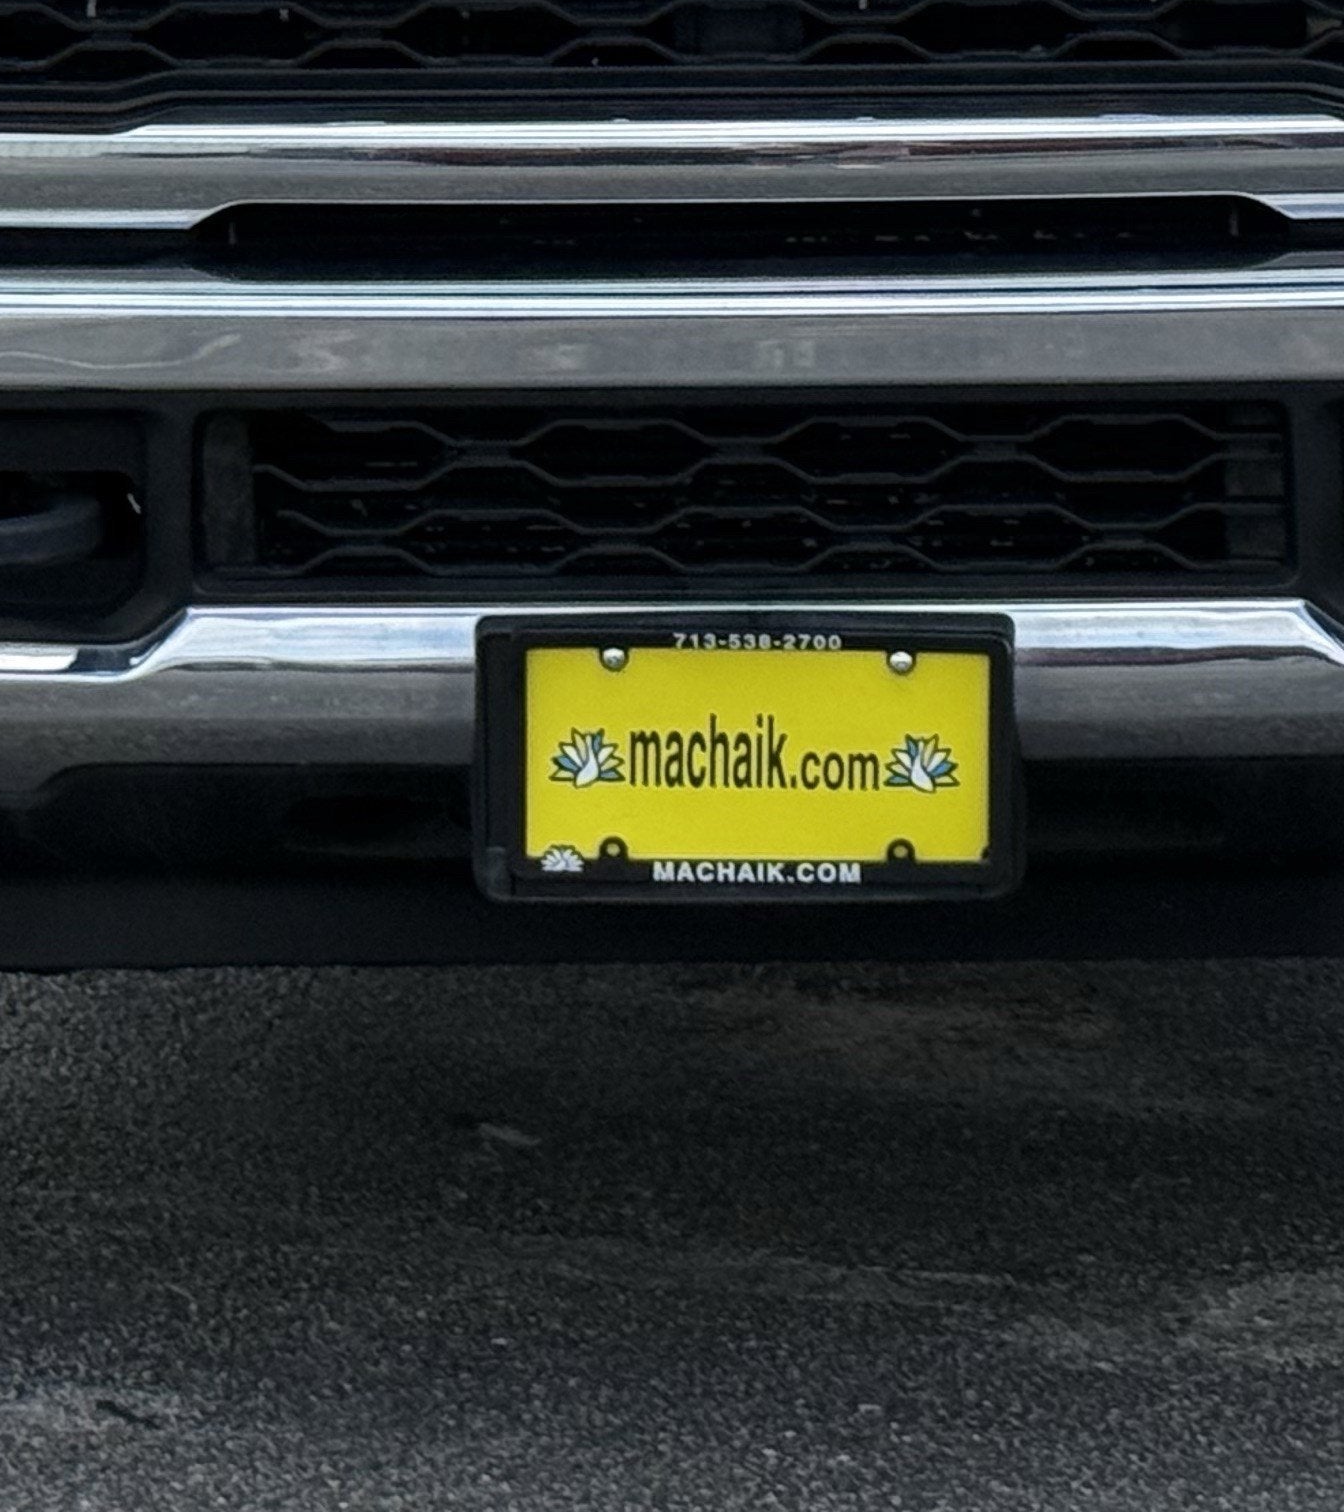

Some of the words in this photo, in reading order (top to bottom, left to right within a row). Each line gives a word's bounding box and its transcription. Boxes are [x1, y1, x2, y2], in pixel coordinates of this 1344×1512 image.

[672, 632, 843, 651] 713-538-2700
[629, 713, 881, 791] machaik.com
[652, 860, 862, 884] MACHAIK.COM
